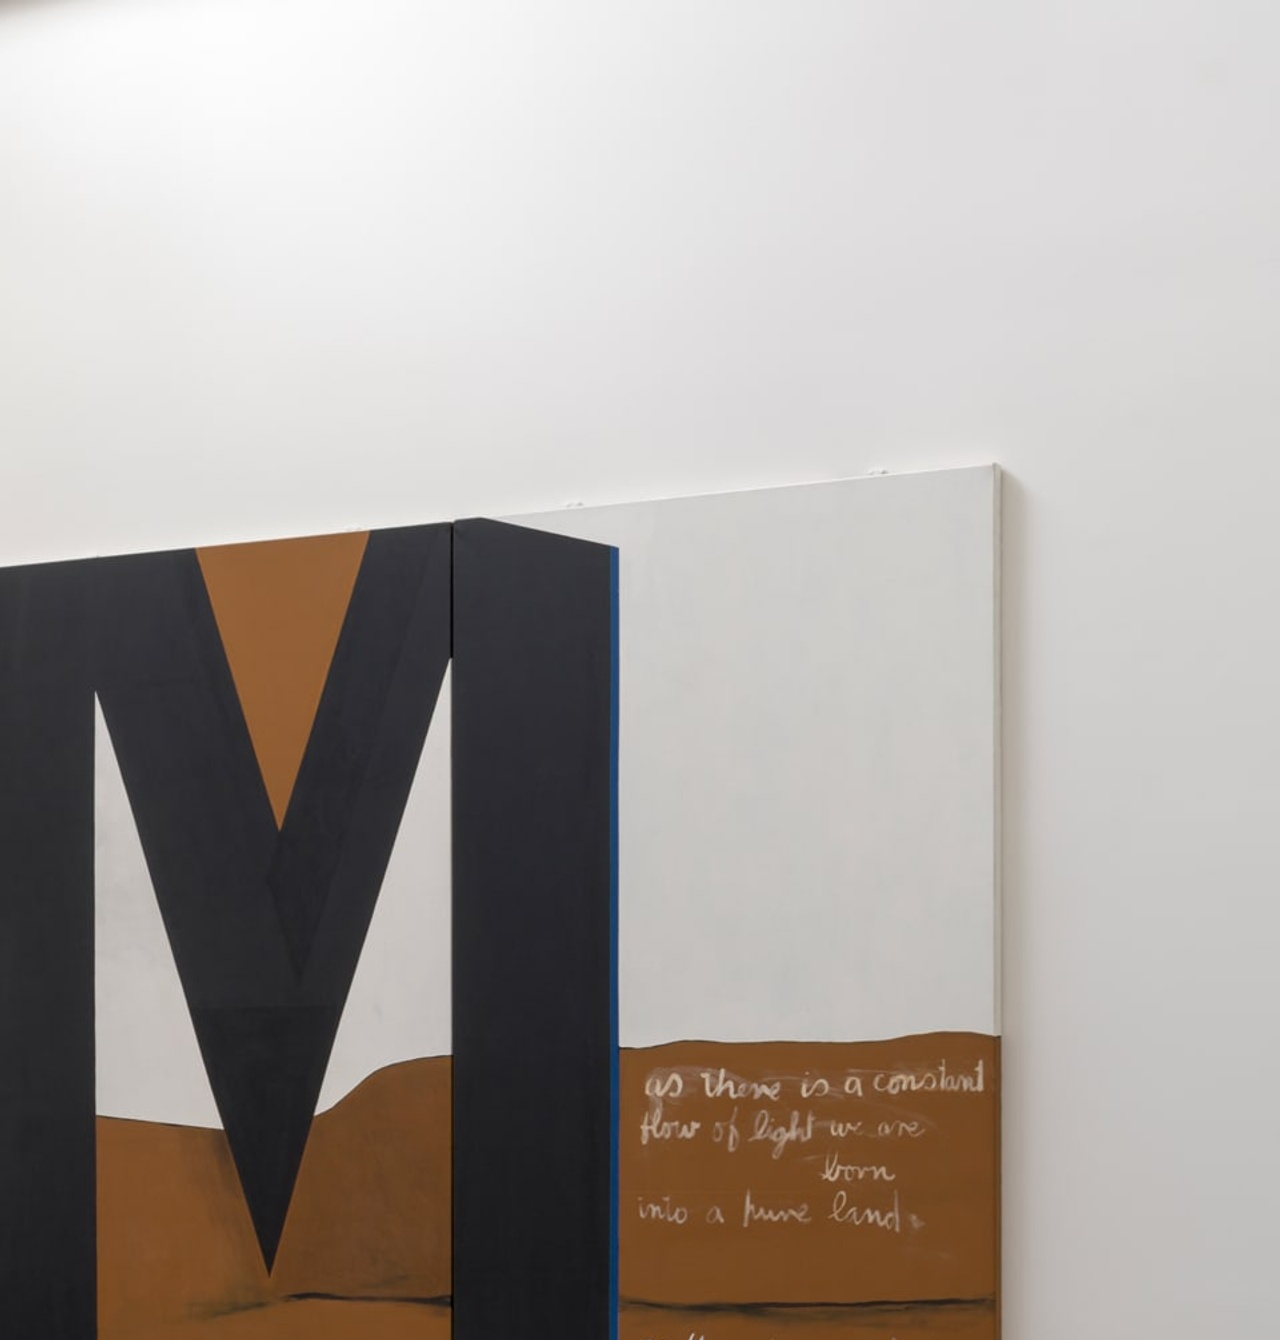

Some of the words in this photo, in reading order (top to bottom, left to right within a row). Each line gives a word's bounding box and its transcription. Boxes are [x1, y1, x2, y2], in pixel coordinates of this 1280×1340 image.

[645, 1072, 683, 1097] as
[700, 1068, 781, 1100] there
[800, 1071, 830, 1099] is
[844, 1075, 863, 1097] a
[873, 1059, 985, 1096] constant
[640, 1107, 701, 1145] flow
[713, 1107, 740, 1153] of
[748, 1109, 815, 1160] light
[830, 1120, 862, 1139] we
[877, 1119, 926, 1138] are
[820, 1153, 896, 1182] born
[638, 1195, 688, 1224] into
[705, 1205, 724, 1224] a
[742, 1187, 812, 1228] pure
